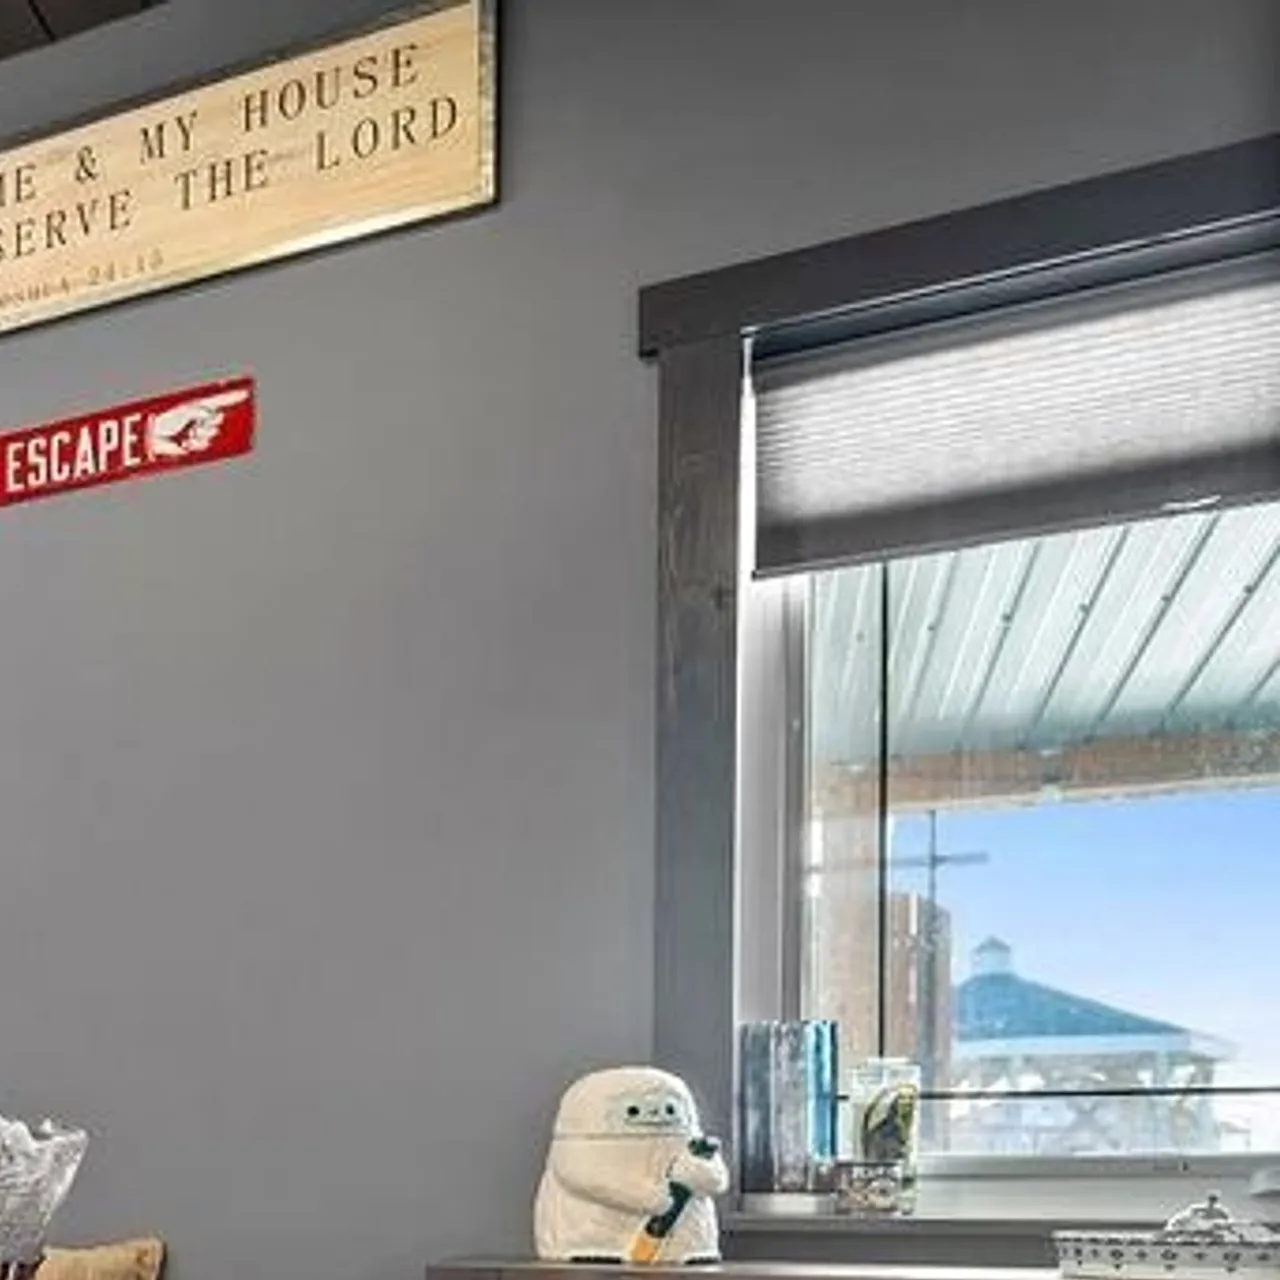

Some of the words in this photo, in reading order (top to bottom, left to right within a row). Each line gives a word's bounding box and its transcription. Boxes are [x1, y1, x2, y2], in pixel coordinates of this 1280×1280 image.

[74, 145, 100, 184] &
[139, 109, 199, 166] MY
[243, 43, 419, 133] HOUSE
[174, 149, 269, 211] THE
[316, 96, 459, 172] LORD
[6, 409, 143, 493] ESCAPE
